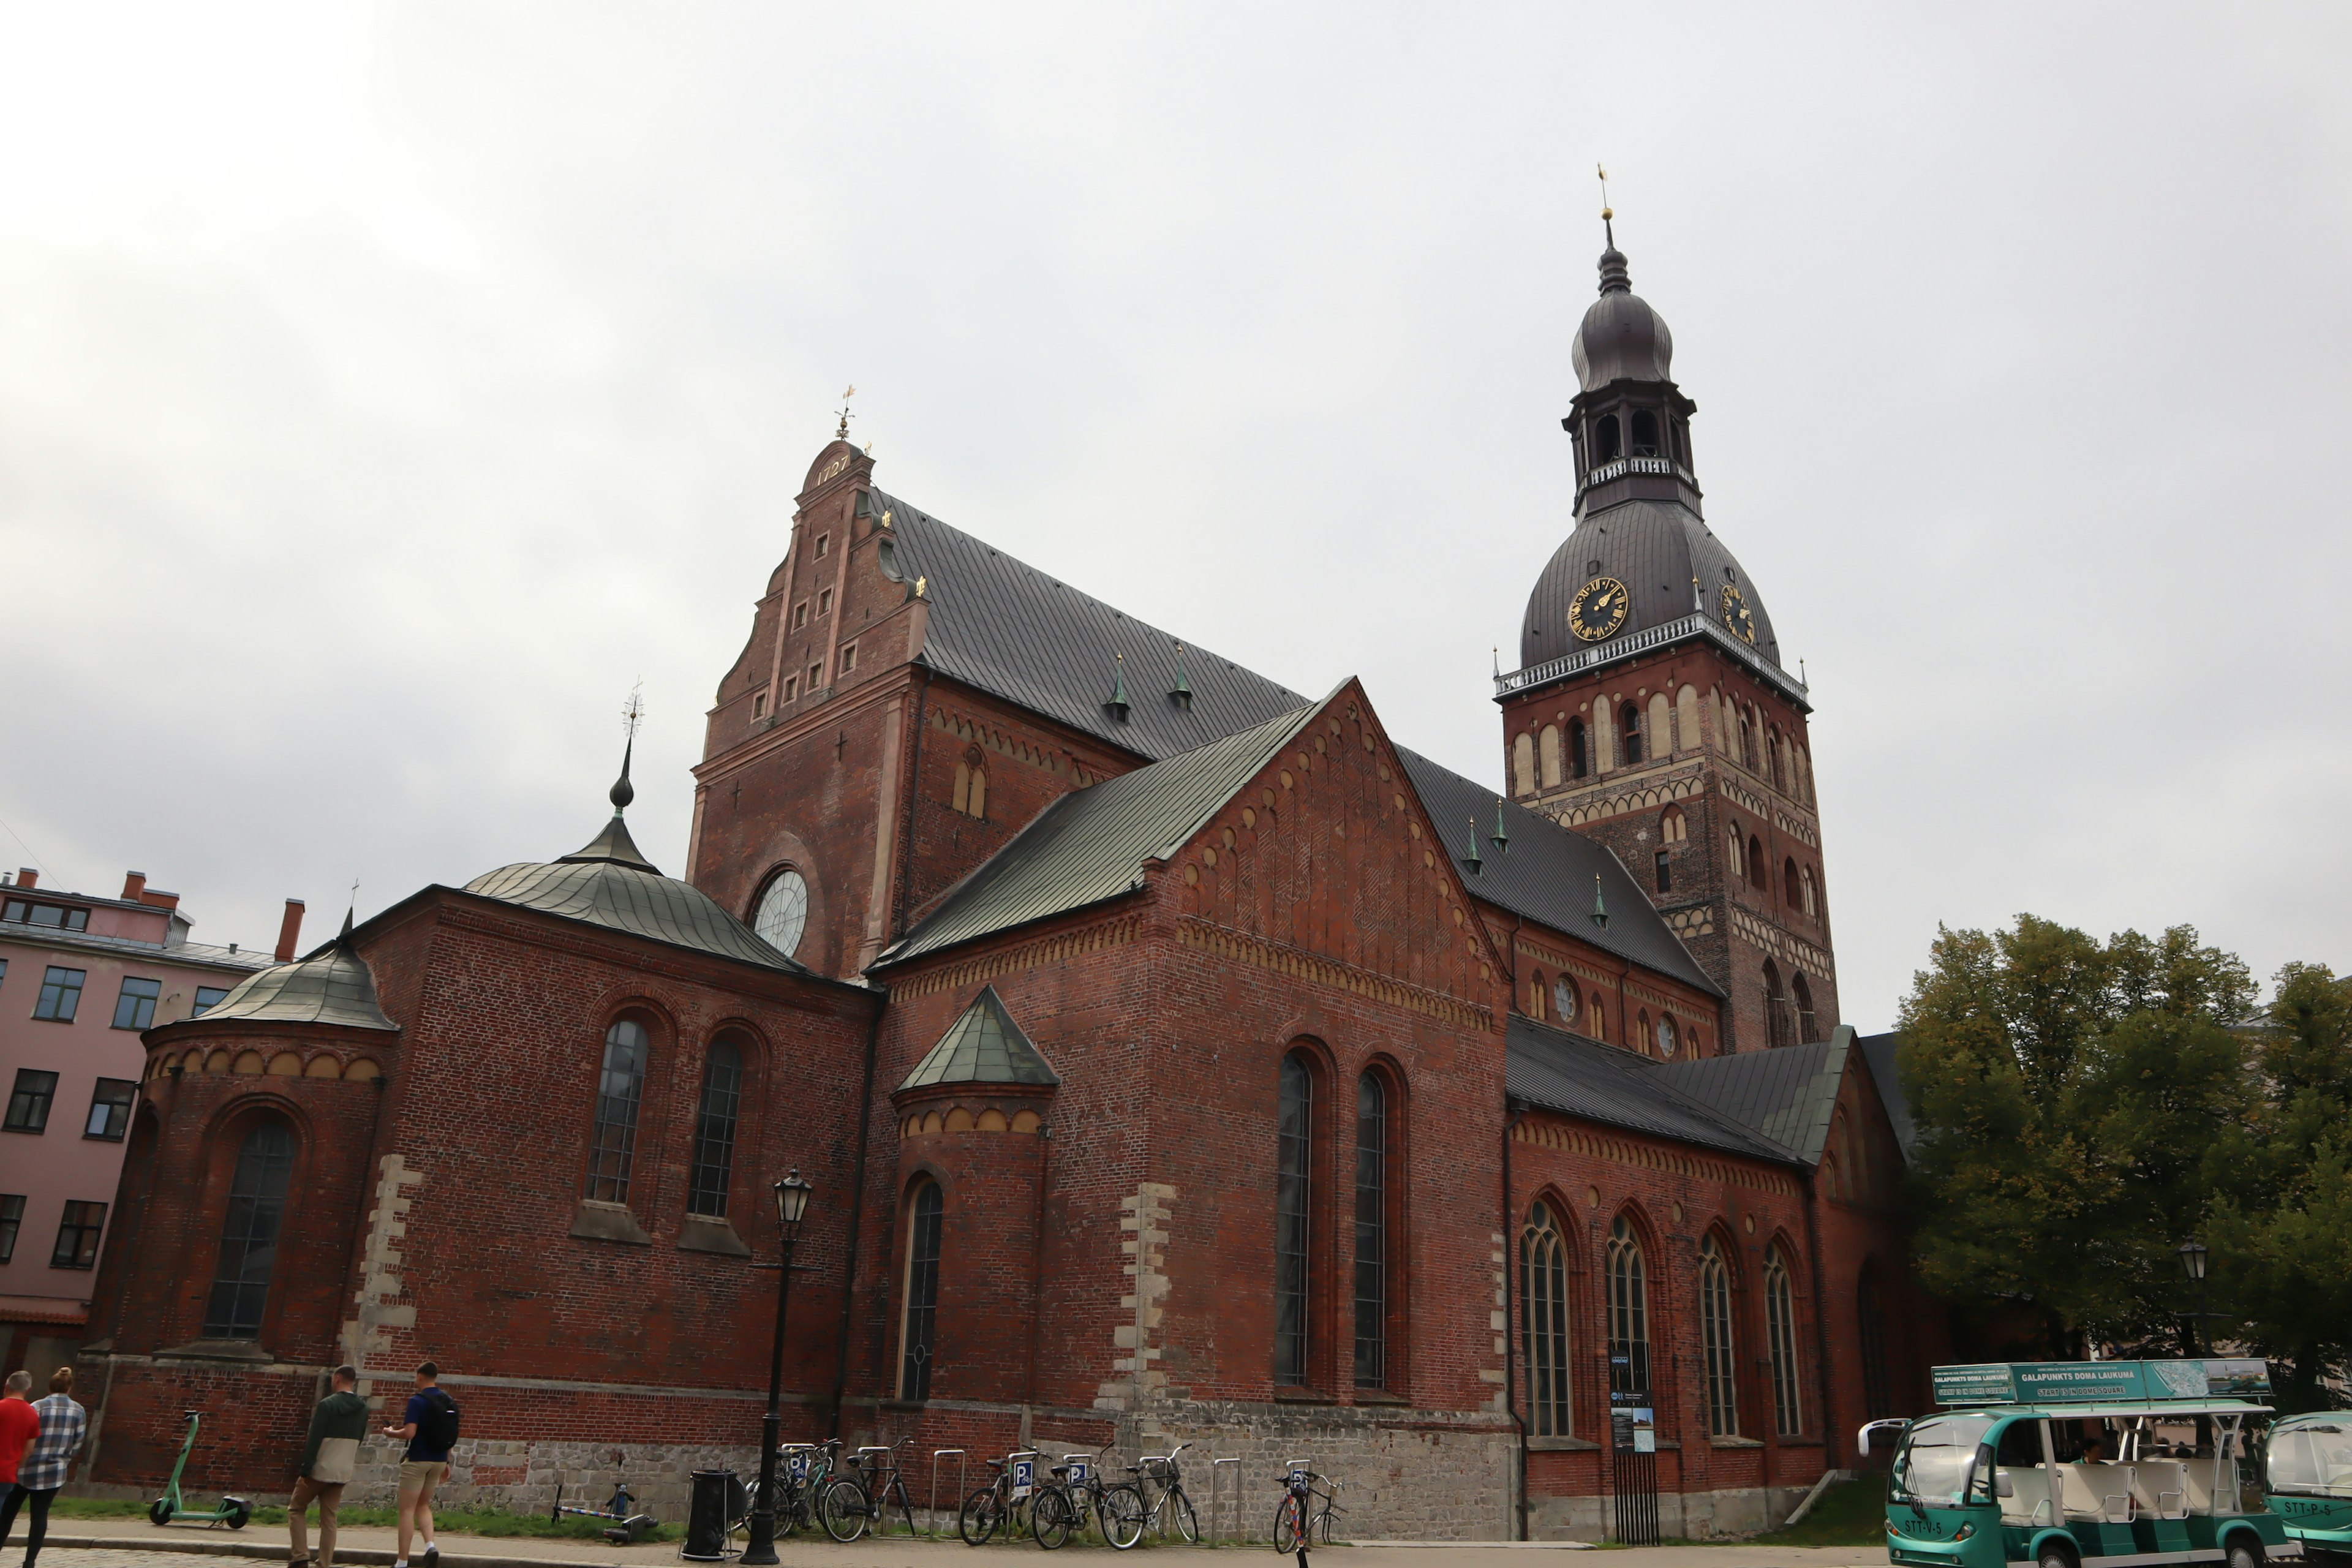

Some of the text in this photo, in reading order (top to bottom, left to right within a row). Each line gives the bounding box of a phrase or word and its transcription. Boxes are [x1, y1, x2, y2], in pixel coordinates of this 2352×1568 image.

[818, 455, 848, 486] 1727
[2022, 1373, 2073, 1382] GALAPUNKTS
[2098, 1370, 2135, 1379] LAUKUMĀ
[1017, 1466, 1026, 1484] P
[1071, 1467, 1080, 1483] P
[2285, 1502, 2331, 1515] STT-P-5
[1905, 1520, 1942, 1534] STT-V-5
